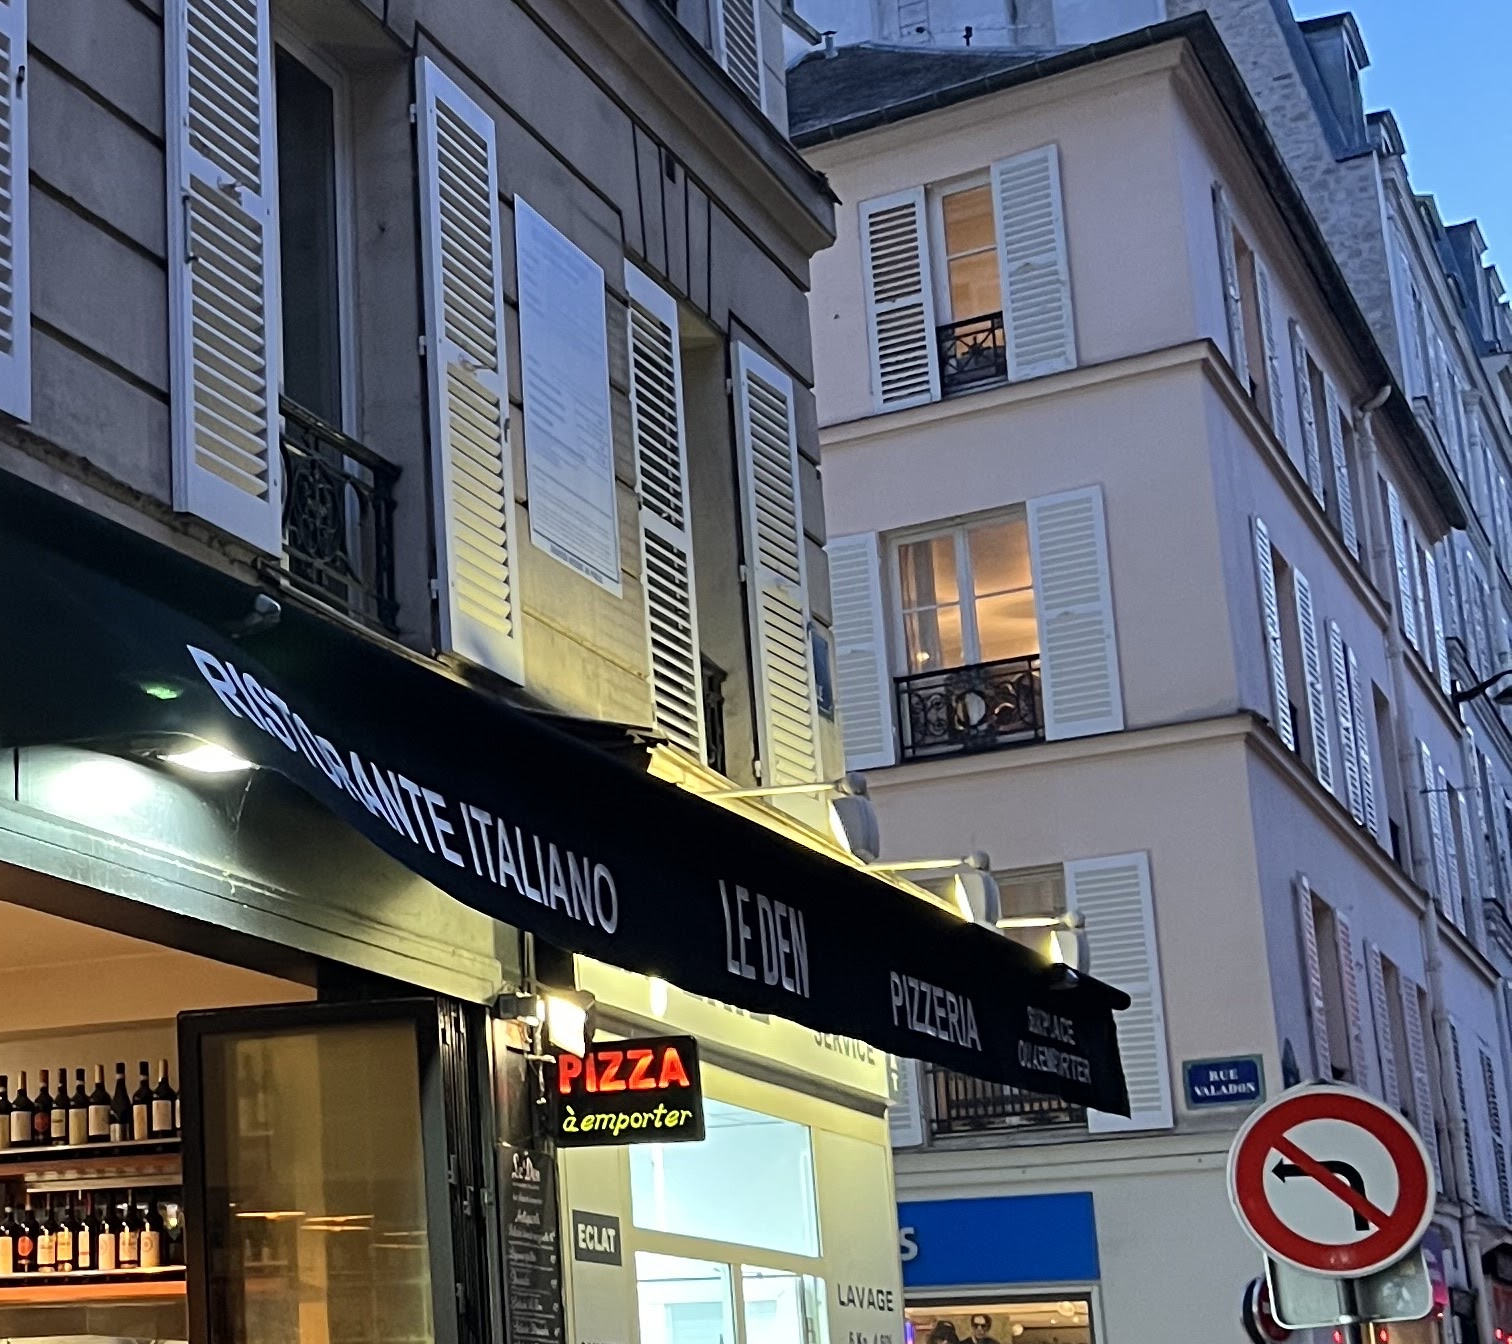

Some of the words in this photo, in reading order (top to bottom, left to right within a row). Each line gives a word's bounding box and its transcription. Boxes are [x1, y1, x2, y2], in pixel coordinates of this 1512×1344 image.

[187, 644, 466, 869] RISTORANTE
[459, 801, 620, 935] ITALIANO
[718, 878, 757, 981] LE
[756, 892, 811, 999] DEN
[889, 969, 984, 1053] PIZZERIA
[558, 1045, 690, 1094] PIZZA
[1209, 1067, 1239, 1082] RUE
[1194, 1081, 1256, 1097] VALADON
[562, 1104, 580, 1132] à
[580, 1104, 694, 1137] emporter
[577, 1223, 616, 1254] ECLAT
[837, 1283, 895, 1312] LAVAGE
